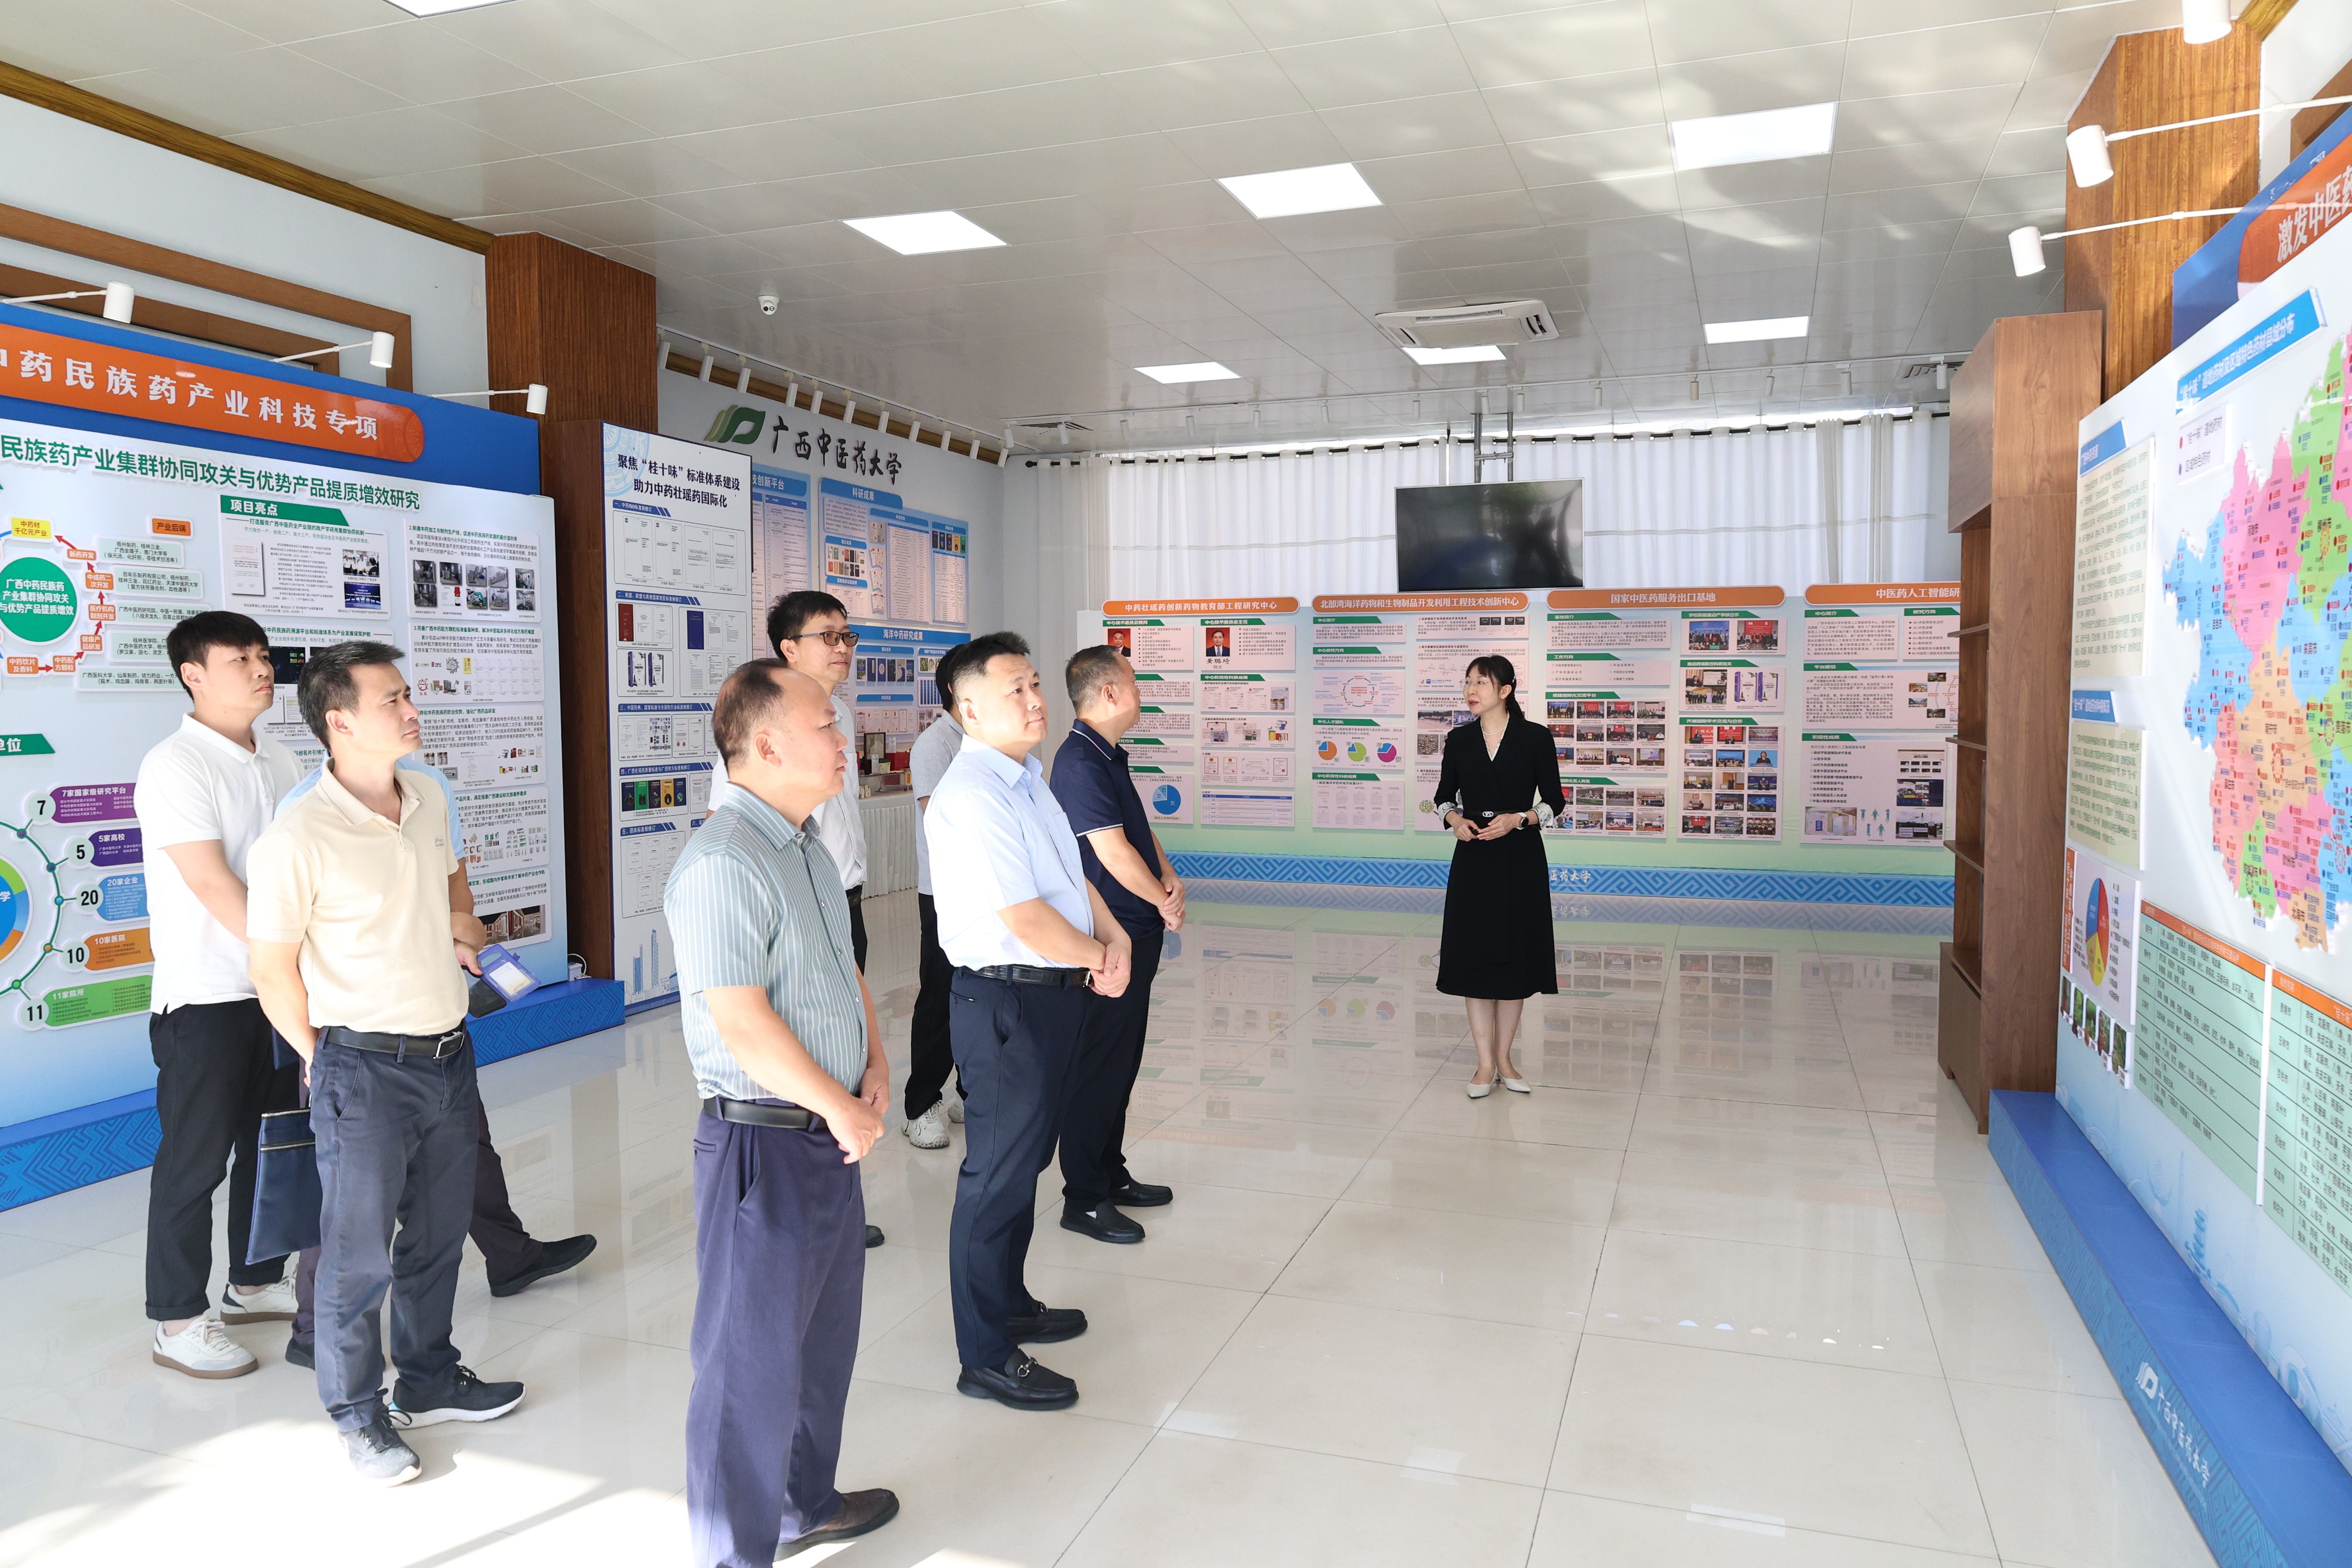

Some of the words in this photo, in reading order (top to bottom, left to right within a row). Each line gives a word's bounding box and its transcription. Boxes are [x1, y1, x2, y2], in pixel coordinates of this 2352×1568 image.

[2277, 165, 2352, 263] 激发中医药
[0, 347, 377, 440] 药民族药产业科技专项
[773, 416, 902, 485] 广西中医药大学
[2, 435, 420, 509] 民族药产业集群协同攻关与优势产品提质增效研究
[634, 479, 727, 508] 助力中药壮瑶药国际化
[852, 488, 875, 501] 科研成果
[231, 500, 278, 515] 项目亮点
[15, 528, 47, 536] 千亿元产业
[157, 523, 186, 533] 产业后端
[6, 579, 64, 591] 广西中药民族药
[3, 591, 69, 603] 产业集群协同攻关
[1611, 593, 1716, 604] 国家中医药服务出口基地
[1876, 587, 1961, 599] 中医药人工智能研
[0, 603, 74, 615] 与优势产品提质增效
[1125, 602, 1277, 612] 中药壮瑶药创新药物教育部工程研究中心
[1321, 598, 1519, 608] 北部湾海洋药物和生物制品开发利用工程技术创新中心
[883, 629, 923, 641] 海洋中药研究成果
[62, 787, 126, 797] 7家国家级研究平台
[37, 800, 45, 815] 7
[622, 826, 656, 835] 五、团体标准制修订
[99, 834, 125, 842] 5家高校
[76, 845, 85, 860] 5
[1550, 869, 1591, 882] 医药大学
[108, 878, 138, 886] 20家企业
[0, 891, 10, 902] 学
[80, 890, 99, 906] 20
[95, 935, 125, 944] 10家医院
[67, 948, 85, 964] 10
[52, 989, 85, 1000] 11家院所
[27, 1005, 43, 1021] 11
